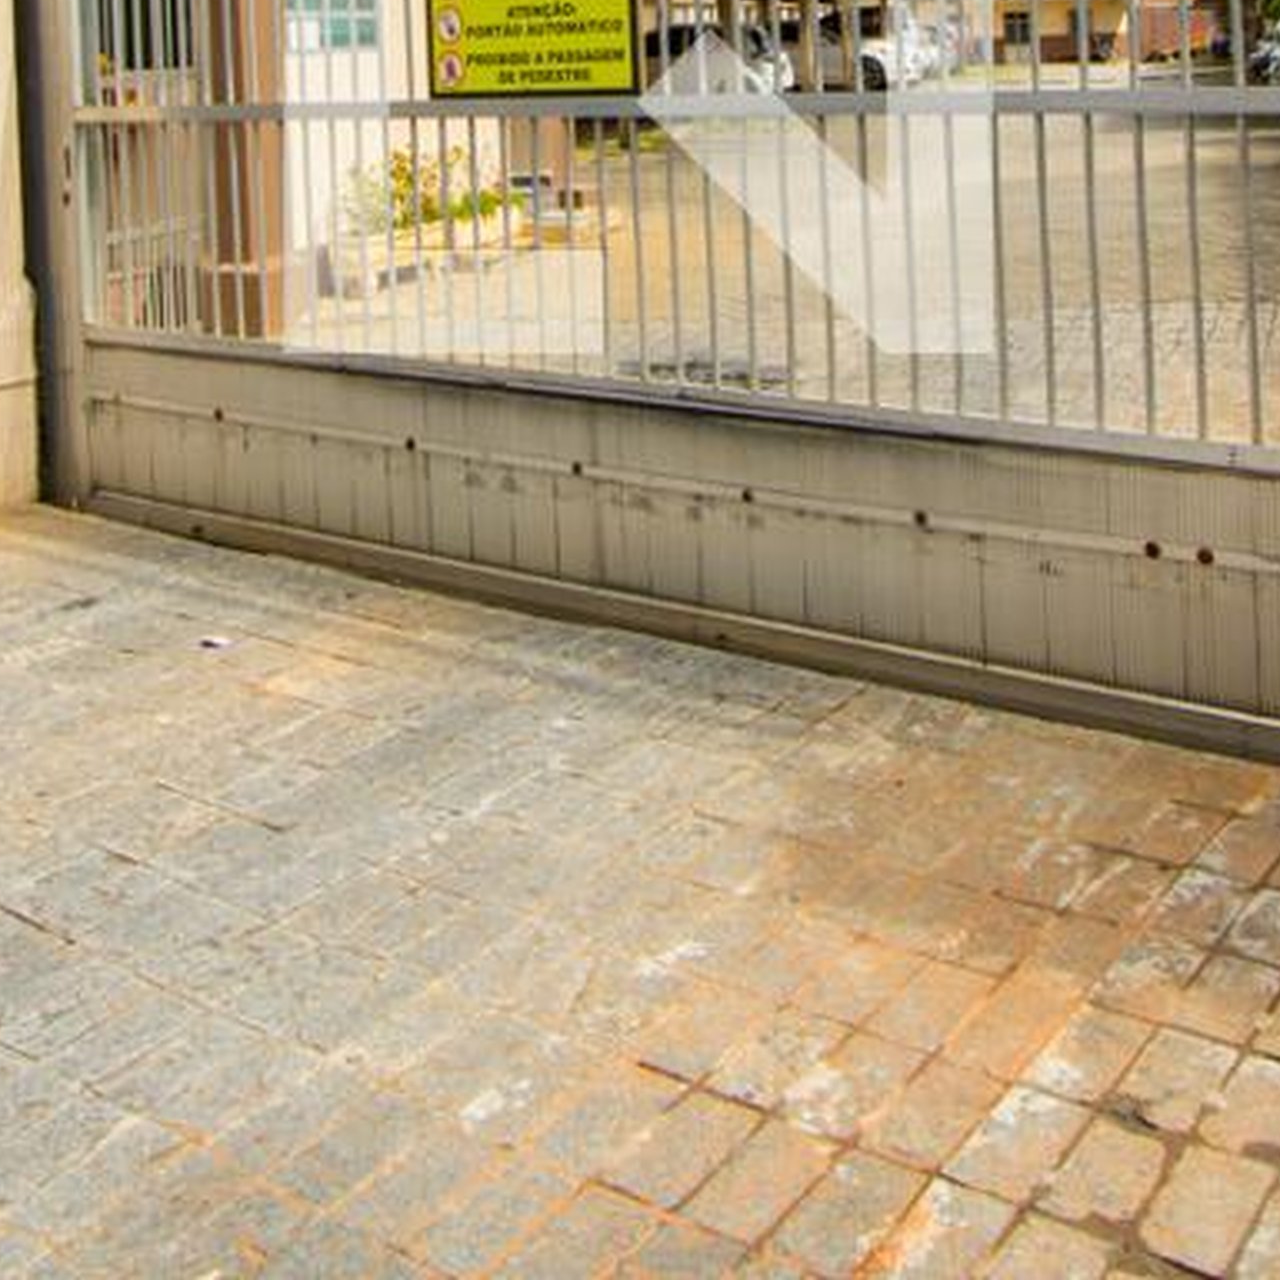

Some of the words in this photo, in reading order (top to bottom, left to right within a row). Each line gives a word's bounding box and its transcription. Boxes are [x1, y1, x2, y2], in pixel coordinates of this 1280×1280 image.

[466, 51, 530, 67] PROIBIDO
[534, 51, 544, 64] A
[548, 48, 626, 64] PASSAGEM
[498, 70, 515, 84] DE
[520, 68, 591, 84] PEDESTRE
